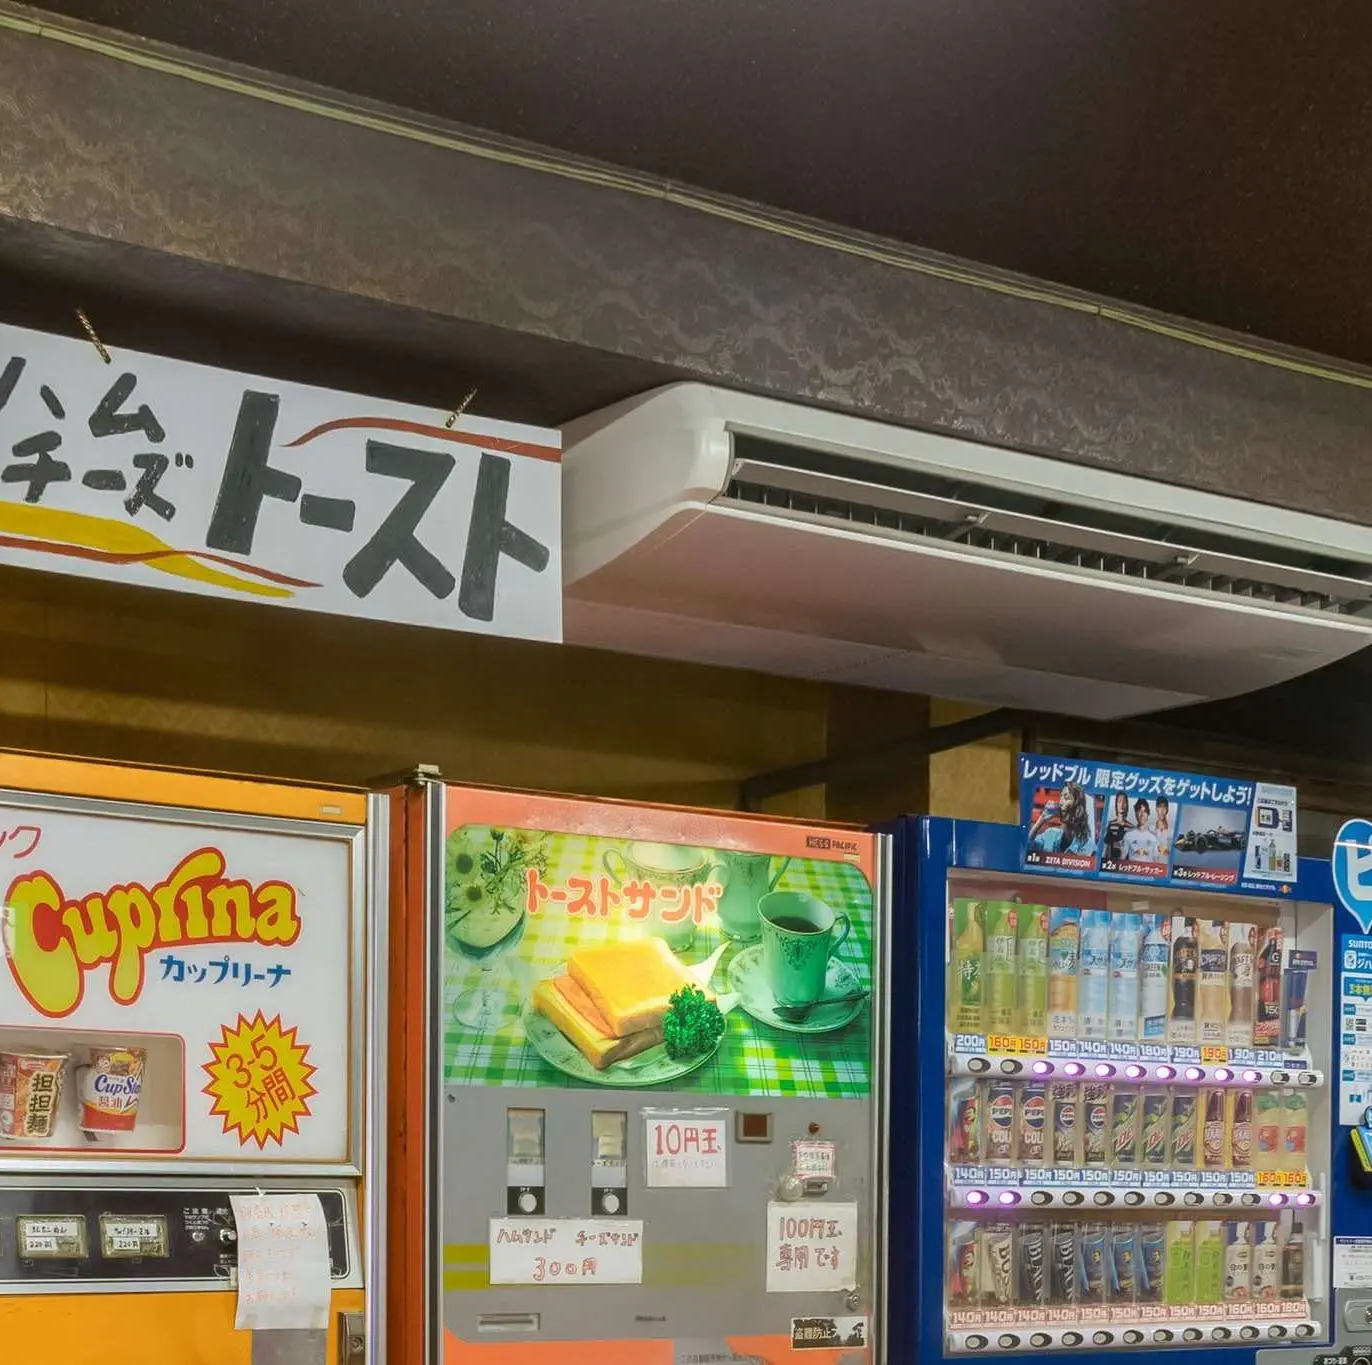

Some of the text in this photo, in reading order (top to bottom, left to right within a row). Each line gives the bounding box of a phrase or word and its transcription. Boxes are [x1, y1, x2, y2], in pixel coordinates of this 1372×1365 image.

[1, 431, 194, 521] チーズ
[206, 390, 550, 622] トースト
[1023, 759, 1091, 785] レッドブル
[526, 869, 724, 924] トーストサンド
[6, 847, 302, 1018] Cuprina
[158, 955, 293, 989] カップリーナ
[94, 1074, 124, 1096] Cup
[226, 1033, 278, 1088] 3-5
[245, 1067, 296, 1123] 分間
[779, 1216, 843, 1240] 100円玉
[532, 1256, 598, 1281] 300円
